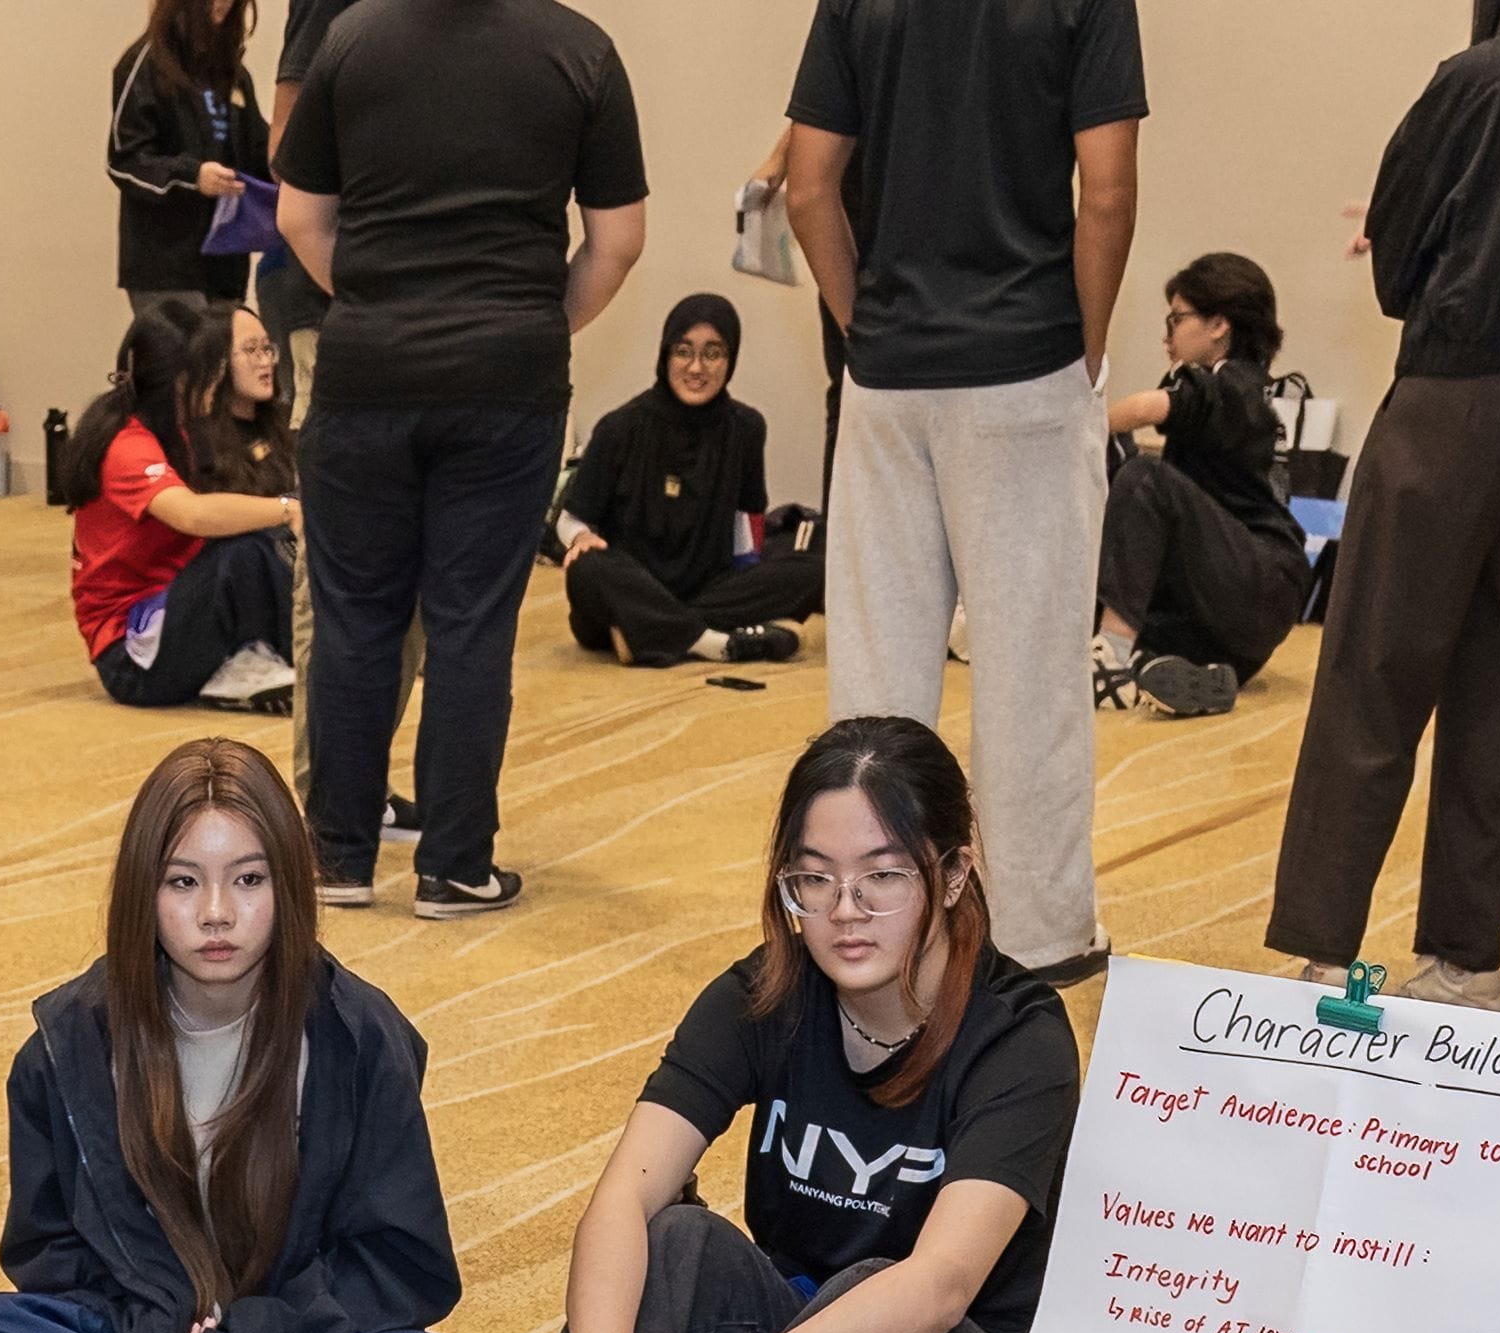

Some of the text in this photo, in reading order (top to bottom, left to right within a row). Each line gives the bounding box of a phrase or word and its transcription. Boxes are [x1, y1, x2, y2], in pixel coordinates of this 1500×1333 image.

[1192, 987, 1410, 1063] Character
[1114, 1070, 1210, 1123] Target
[1359, 1116, 1460, 1166] Primary
[789, 1180, 843, 1207] NANYANG
[1353, 1153, 1433, 1181] school
[1102, 1190, 1320, 1252] Values we want to
[1107, 1252, 1240, 1305] Integrity
[1183, 1314, 1207, 1333] of
